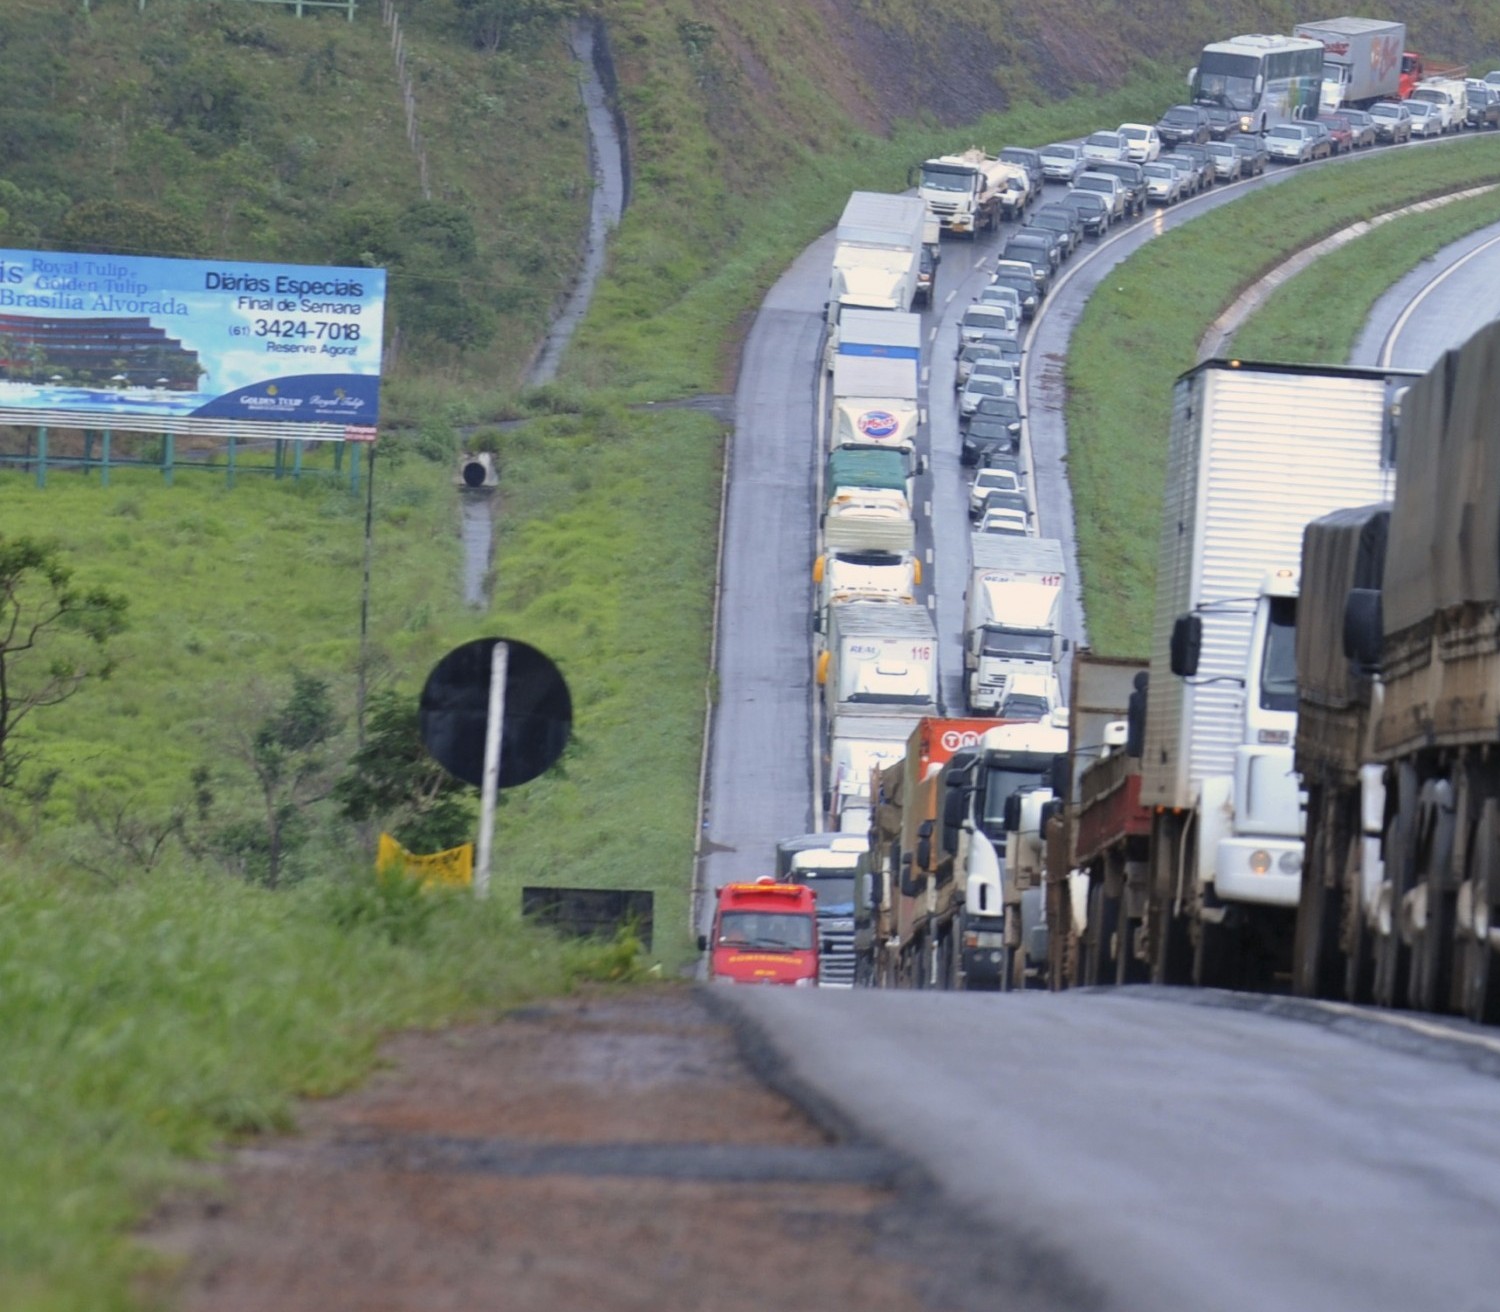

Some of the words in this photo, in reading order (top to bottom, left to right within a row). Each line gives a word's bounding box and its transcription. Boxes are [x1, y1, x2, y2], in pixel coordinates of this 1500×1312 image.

[32, 258, 78, 276] Royal
[86, 262, 129, 279] Tulip
[35, 275, 97, 292] Golden
[105, 279, 148, 298] Tulip
[206, 272, 270, 293] Diárias
[275, 276, 364, 299] Especiais
[91, 294, 189, 316] Alvorada
[238, 296, 273, 311] Final
[277, 299, 296, 312] de
[300, 299, 362, 315] Semana
[255, 318, 361, 341] 3424-7018
[266, 341, 317, 353] Reserve
[1041, 576, 1061, 587] 117
[911, 646, 931, 660] 116
[941, 731, 983, 751] TN
